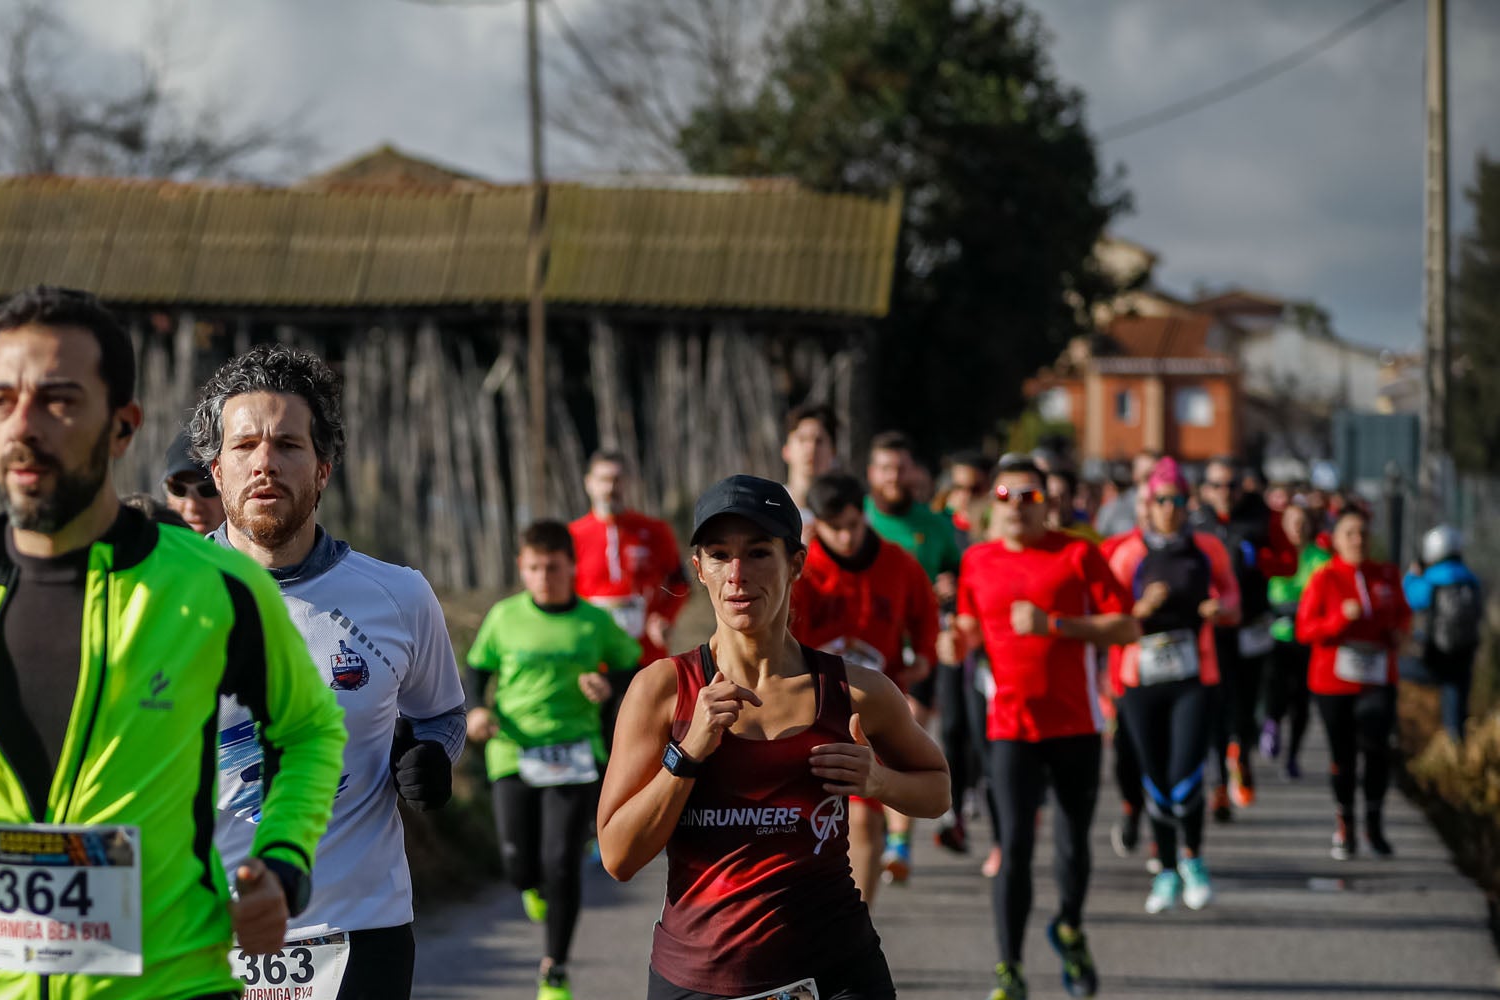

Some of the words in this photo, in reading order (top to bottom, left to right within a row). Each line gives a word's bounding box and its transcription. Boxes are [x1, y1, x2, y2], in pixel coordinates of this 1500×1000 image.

[48, 921, 77, 941] BEA
[82, 922, 112, 942] BYA
[238, 947, 315, 986] 363
[295, 986, 313, 1000] BYA
